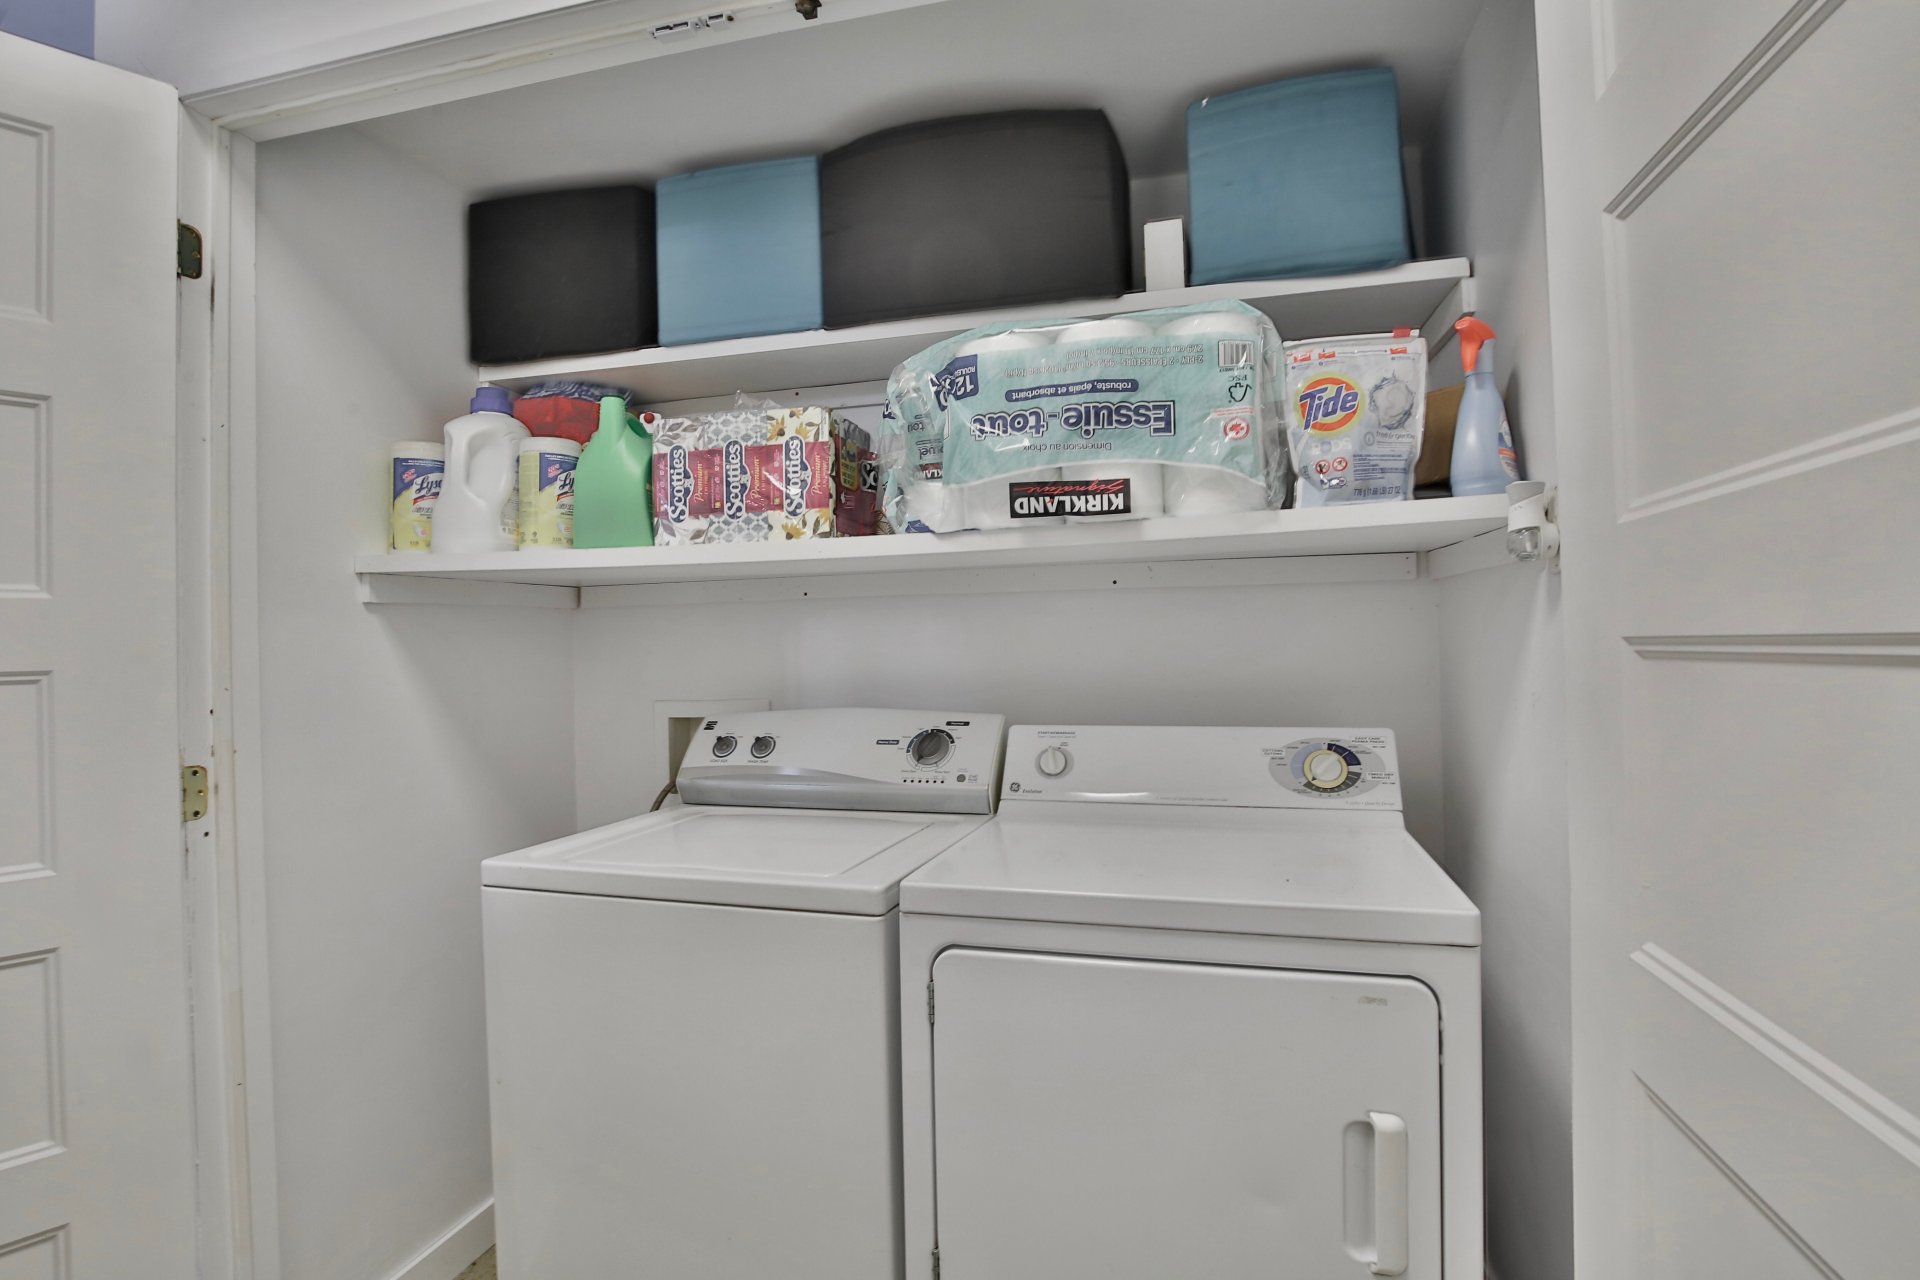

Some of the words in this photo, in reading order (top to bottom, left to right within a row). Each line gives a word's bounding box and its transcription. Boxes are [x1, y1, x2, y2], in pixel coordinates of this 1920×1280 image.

[1012, 388, 1056, 400] absorbant
[1058, 387, 1067, 395] et
[1299, 384, 1359, 431] Tide
[1063, 442, 1112, 451] Dimension
[670, 449, 687, 520] Scotties
[694, 463, 704, 502] Premium
[726, 444, 744, 518] Scotties
[751, 457, 761, 499] Premium
[811, 453, 822, 496] Premium
[1014, 479, 1124, 494] Signature
[1014, 493, 1124, 514] KIRKLAND
